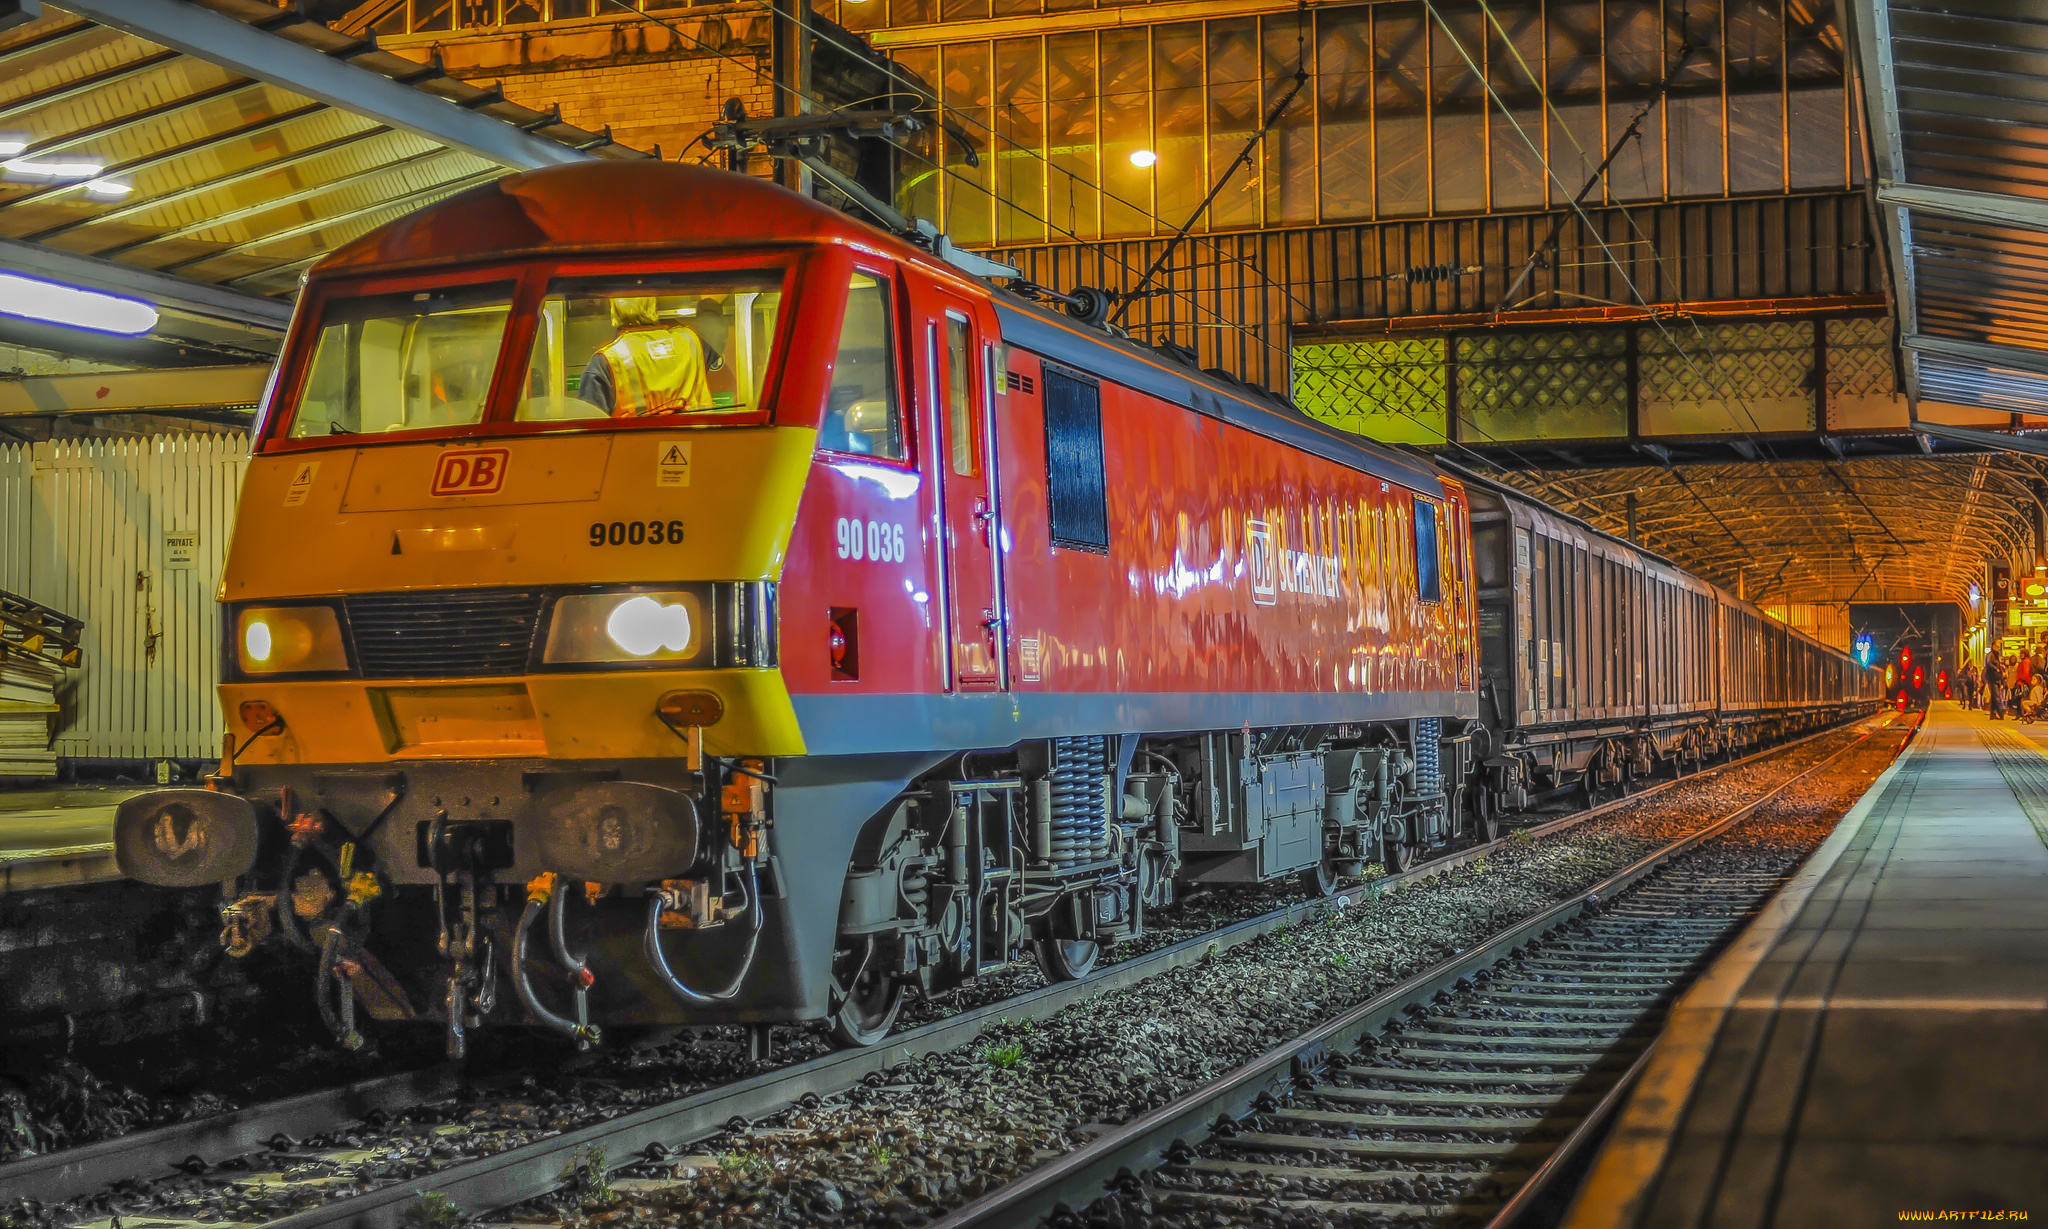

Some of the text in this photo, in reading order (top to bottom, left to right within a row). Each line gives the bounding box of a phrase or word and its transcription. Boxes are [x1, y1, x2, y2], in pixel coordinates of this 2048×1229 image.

[441, 457, 497, 488] DB
[167, 538, 193, 546] PRIVATE
[589, 520, 684, 547] 90036
[837, 517, 905, 563] 90 036
[1251, 530, 1340, 598] DB SCHENKER
